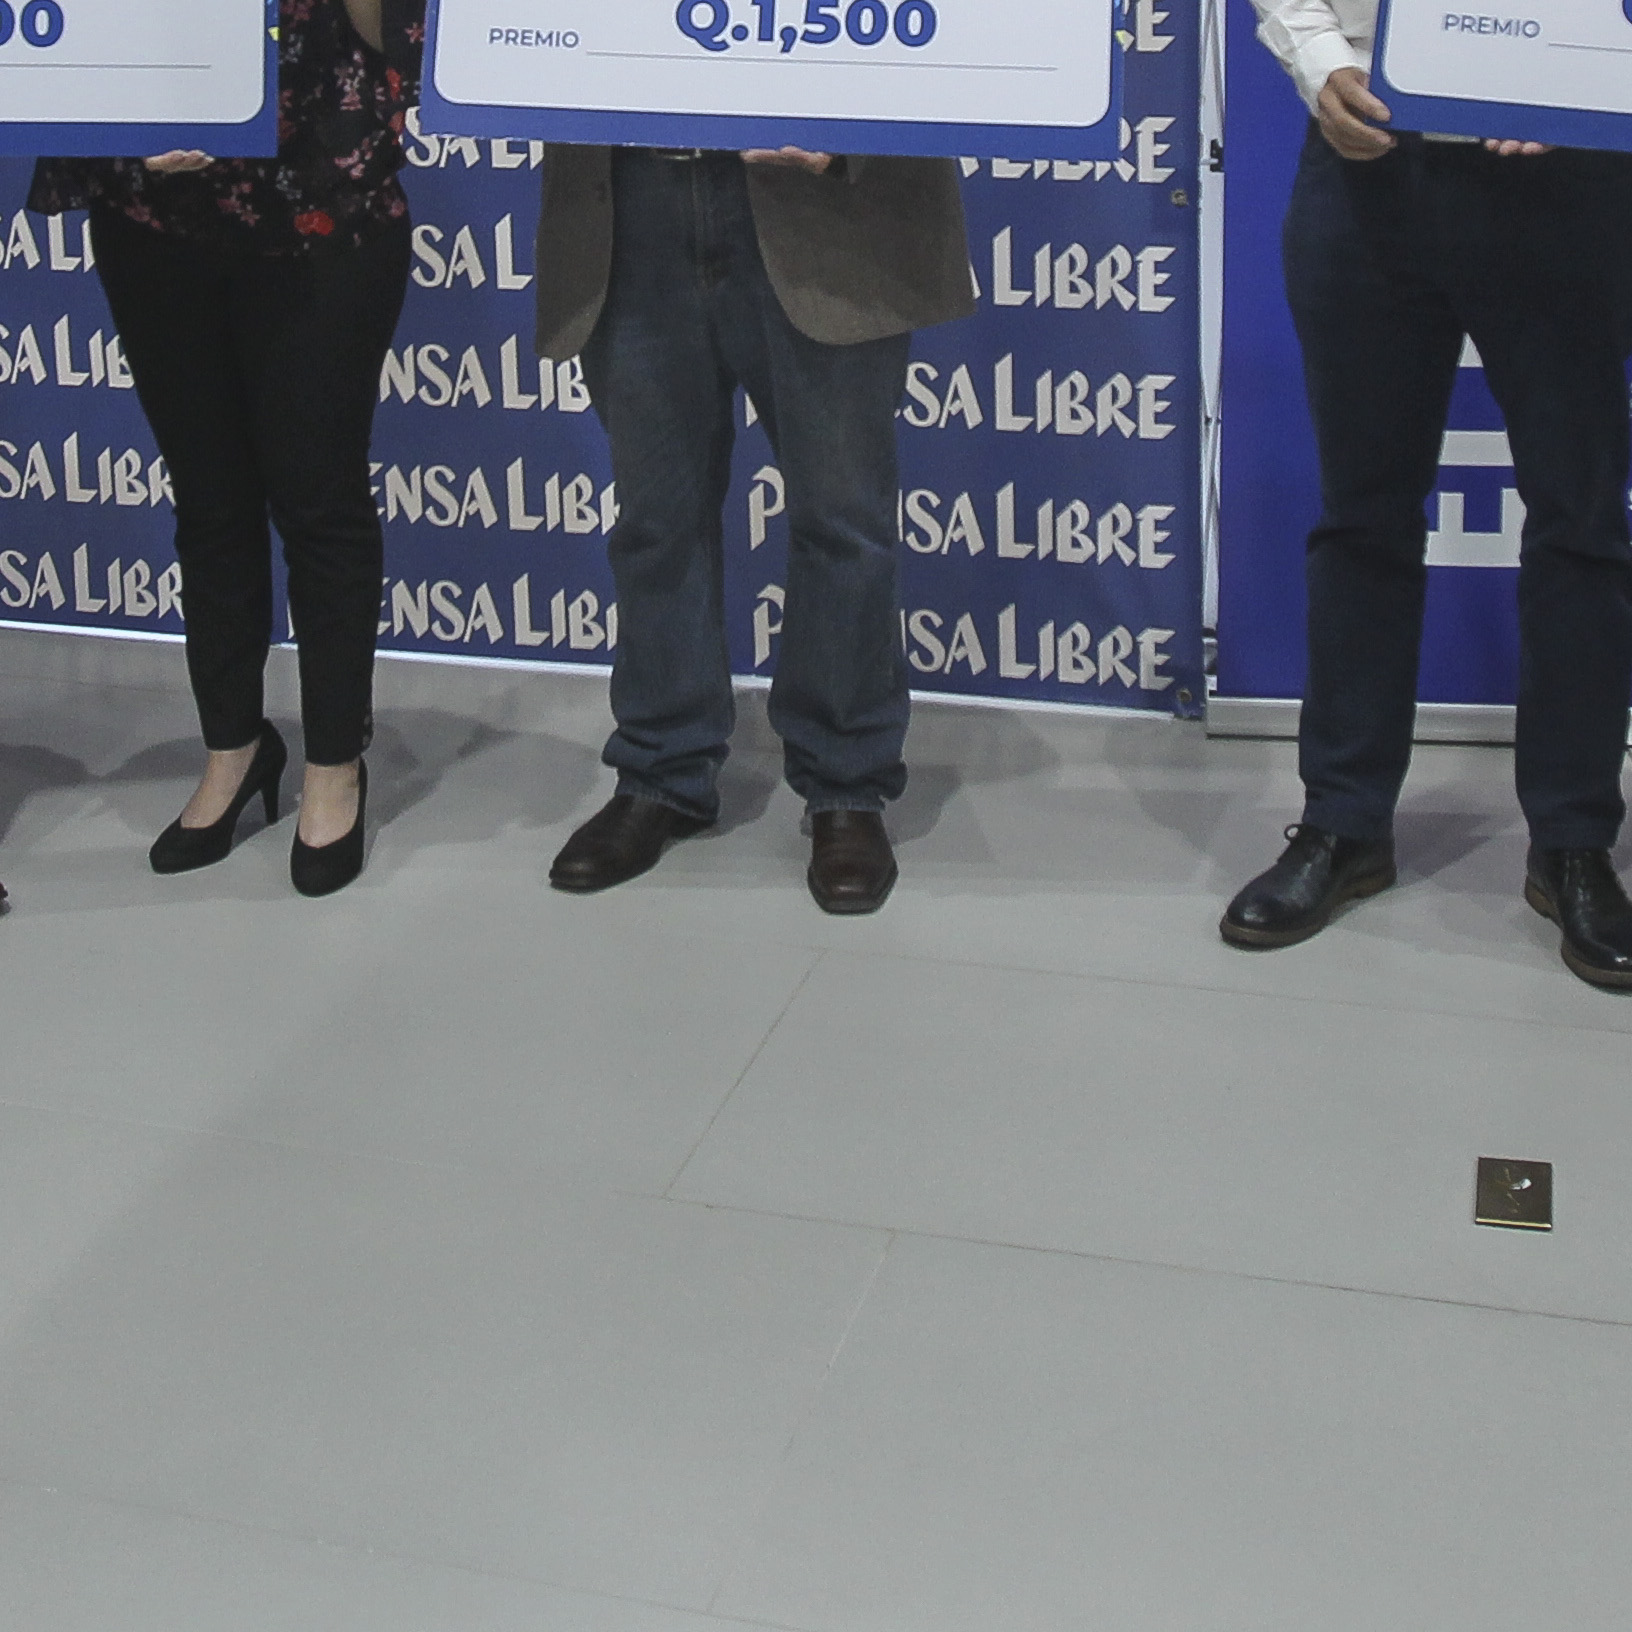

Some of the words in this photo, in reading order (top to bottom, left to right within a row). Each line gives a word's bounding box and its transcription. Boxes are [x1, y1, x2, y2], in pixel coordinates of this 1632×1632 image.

[488, 27, 580, 50] PREMIO
[1443, 12, 1541, 40] PREMIO
[993, 226, 1176, 313] LIBRE
[54, 313, 136, 389] LIB
[379, 344, 492, 408] NSA
[500, 334, 592, 412] LIB
[995, 353, 1176, 439] LIBRE
[63, 431, 176, 507] LIBR
[996, 482, 1176, 568] LIBRE
[74, 543, 185, 619] LIBR
[512, 572, 618, 651] LIB
[997, 603, 1176, 690] LIBRE
